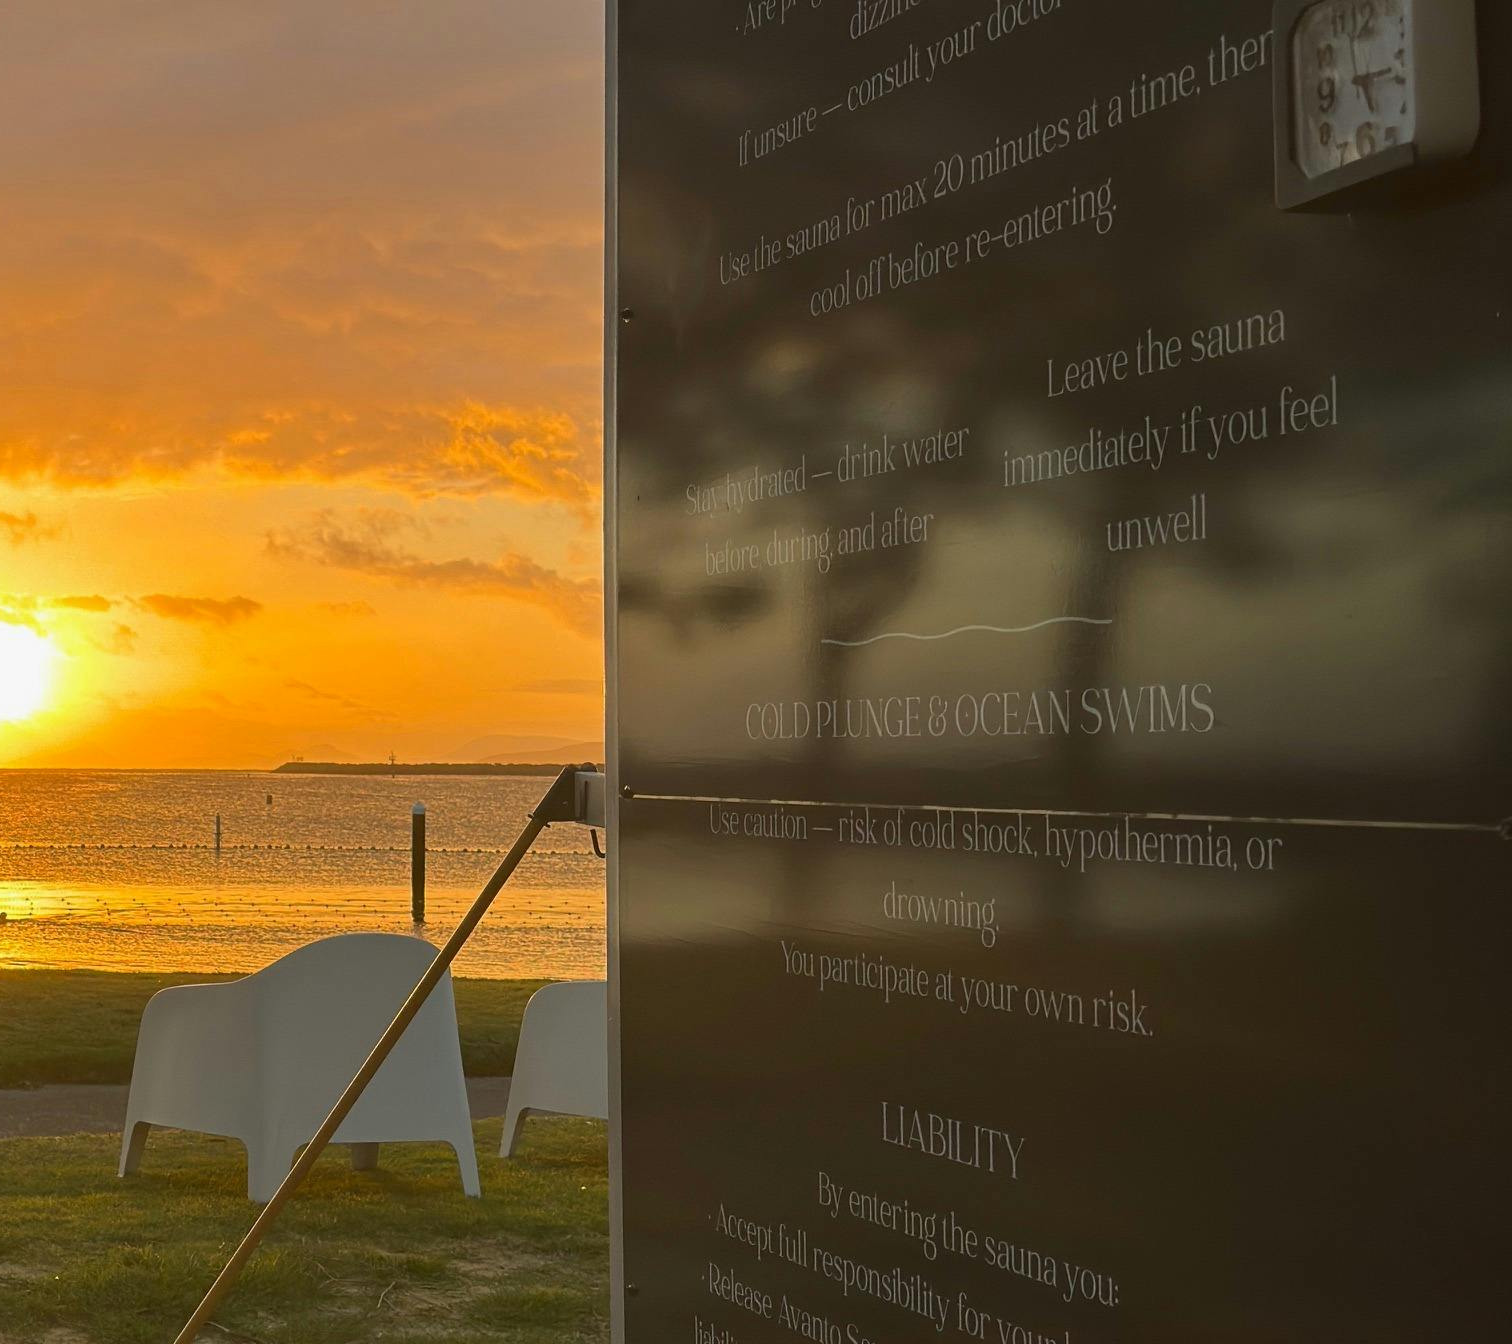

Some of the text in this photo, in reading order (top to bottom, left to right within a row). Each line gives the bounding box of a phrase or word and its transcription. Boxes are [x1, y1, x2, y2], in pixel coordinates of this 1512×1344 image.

[739, 130, 751, 166] If
[755, 107, 817, 158] unsure
[848, 44, 920, 111] consult
[926, 21, 981, 82] your
[1317, 76, 1335, 113] 9
[720, 252, 750, 285] Use
[755, 236, 781, 272] the
[787, 215, 840, 258] sauna
[847, 197, 875, 235] for
[881, 178, 927, 221] max
[934, 154, 964, 198] 20
[971, 118, 1070, 184] minutes
[1077, 98, 1100, 140] at
[1108, 96, 1122, 127] a
[811, 177, 1117, 316] cool off before re-entering.
[1047, 309, 1285, 397] Leave the sauna
[725, 454, 806, 514] hydrated
[838, 435, 896, 482] drink
[903, 428, 969, 467] water
[1004, 375, 1337, 487] immediately if you feel
[838, 512, 874, 554] and
[881, 507, 934, 548] after
[1107, 493, 1206, 551] unwell
[746, 684, 1214, 739] COLD PLUNGE & OCEAN SWIMS
[709, 805, 739, 837] Use
[744, 807, 807, 839] caution
[837, 808, 878, 847] risk
[883, 808, 904, 847] of
[910, 810, 956, 850] cold
[962, 811, 1038, 858] shock,
[1045, 815, 1238, 873] hypothermia,
[1246, 837, 1283, 870] or
[884, 881, 999, 948] drowning.
[781, 941, 1153, 1036] You participate at your own risk.
[882, 1102, 1025, 1179] LIABILITY
[714, 1203, 774, 1261] Accept
[779, 1224, 807, 1267] full
[813, 1248, 950, 1332] responsibility
[957, 1292, 991, 1339] for
[819, 1171, 1119, 1307] By entering the sauna you:
[708, 1262, 772, 1318] Release
